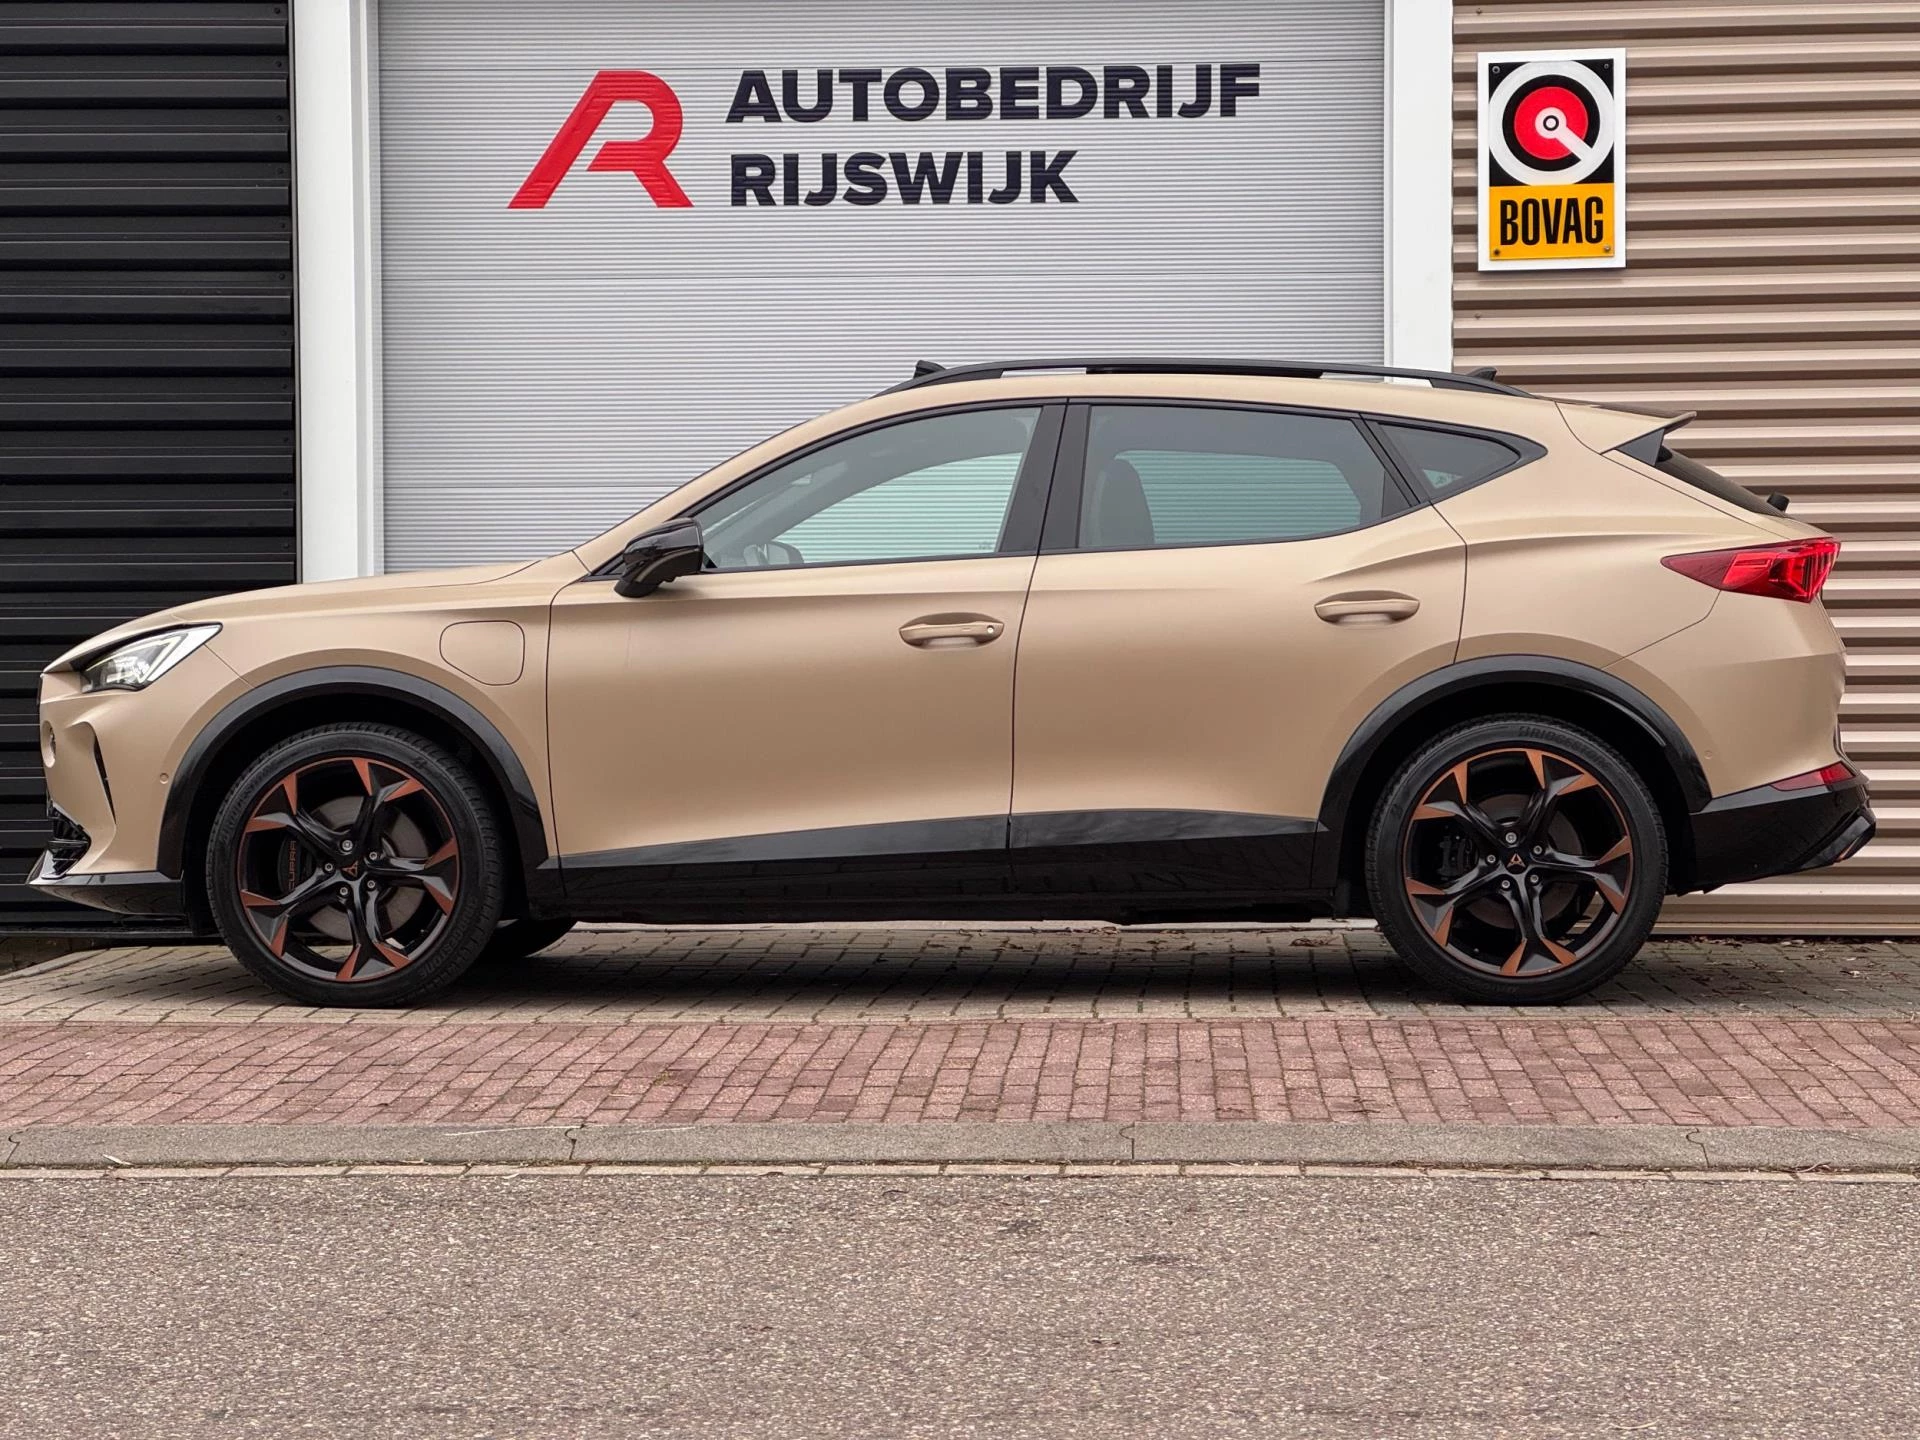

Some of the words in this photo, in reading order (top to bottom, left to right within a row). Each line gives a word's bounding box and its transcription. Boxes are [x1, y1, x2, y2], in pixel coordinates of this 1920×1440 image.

[725, 63, 1261, 123] AUTOBEDRIJF
[730, 150, 1079, 207] RIJSWIJK
[1500, 196, 1604, 246] BOVAG
